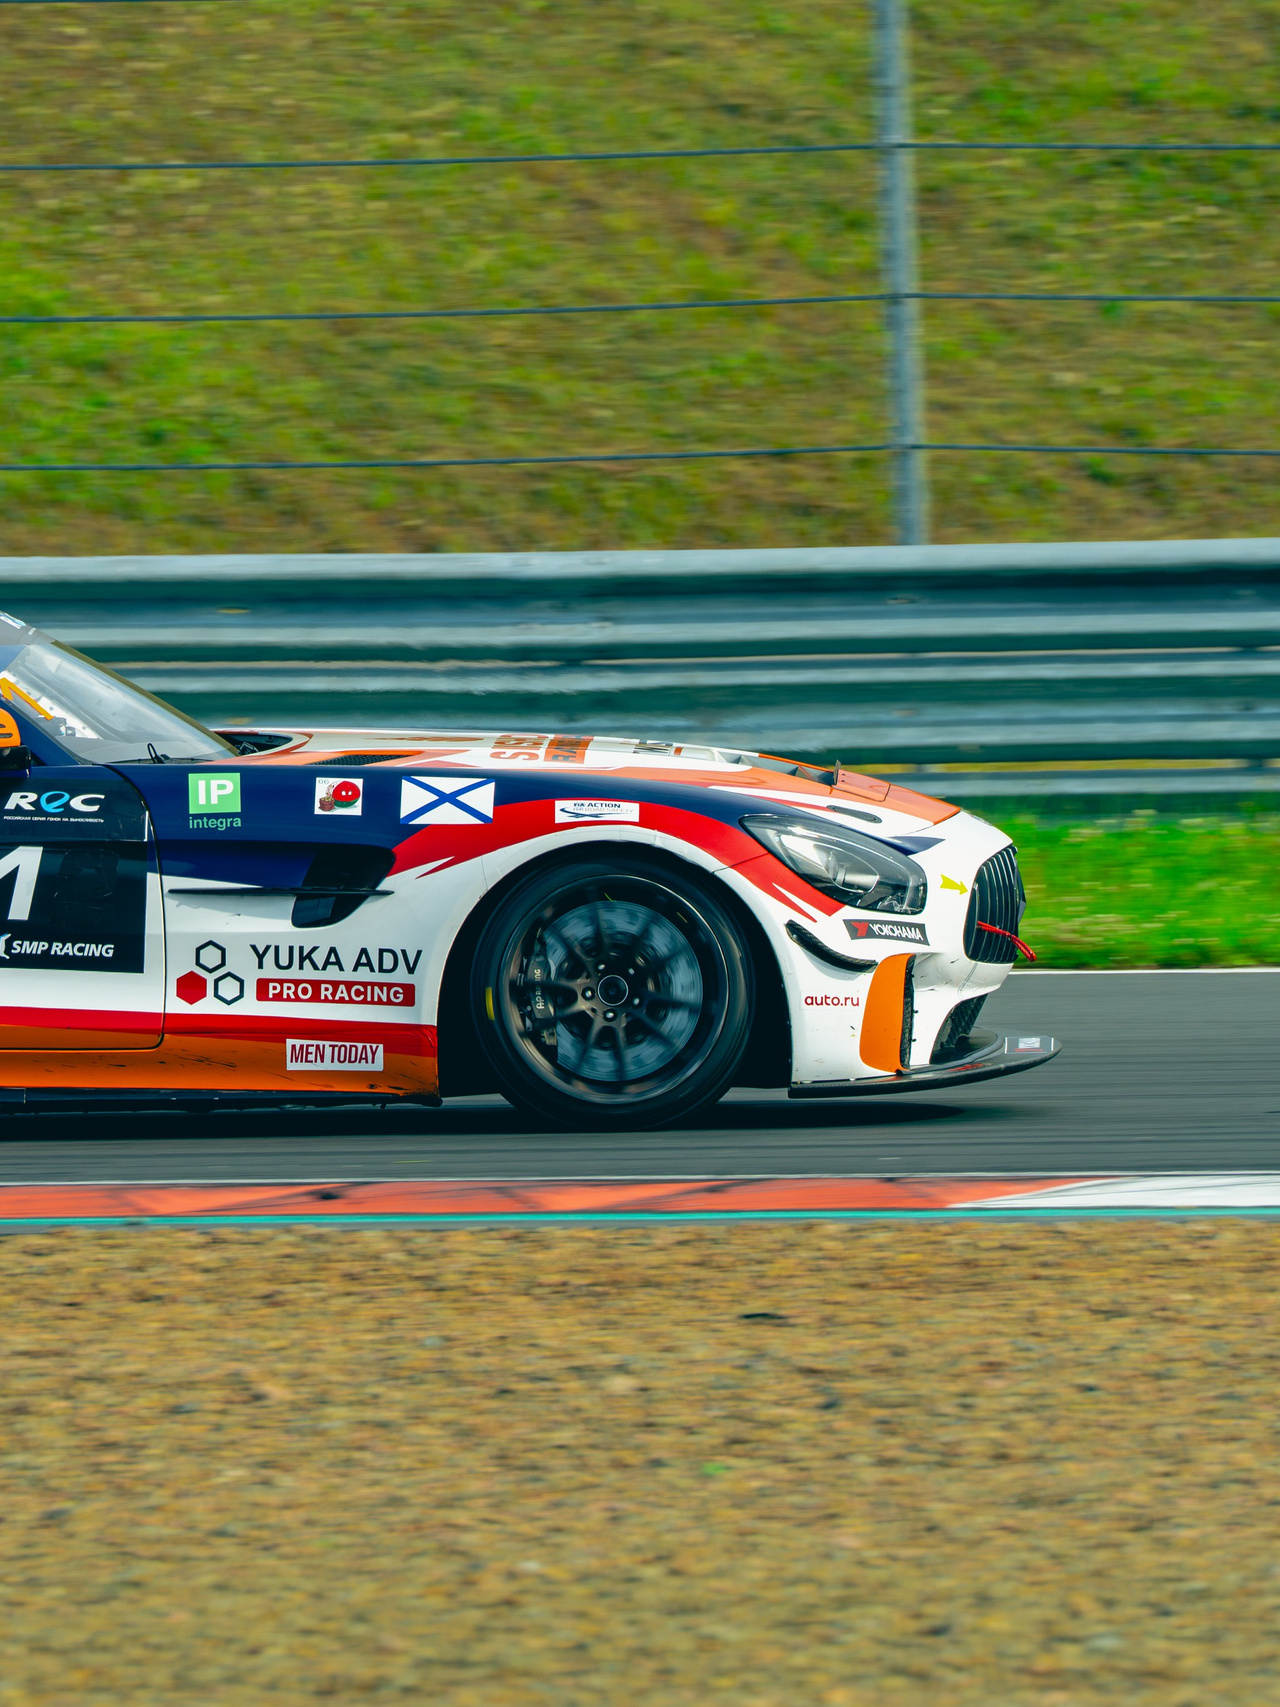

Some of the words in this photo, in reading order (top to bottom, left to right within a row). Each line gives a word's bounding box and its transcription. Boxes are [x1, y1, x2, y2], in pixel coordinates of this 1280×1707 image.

[198, 779, 234, 805] IP
[189, 816, 242, 831] integra
[869, 923, 924, 940] YOKOHAMA
[11, 940, 49, 955] SMP
[51, 942, 115, 958] RACING
[250, 944, 345, 972] YUKA
[352, 947, 423, 975] ADV
[268, 982, 313, 1000] PRO
[320, 984, 404, 1003] RACING
[804, 995, 860, 1007] auto.ru
[290, 1043, 325, 1064] MEN
[329, 1044, 379, 1065] TODAY
